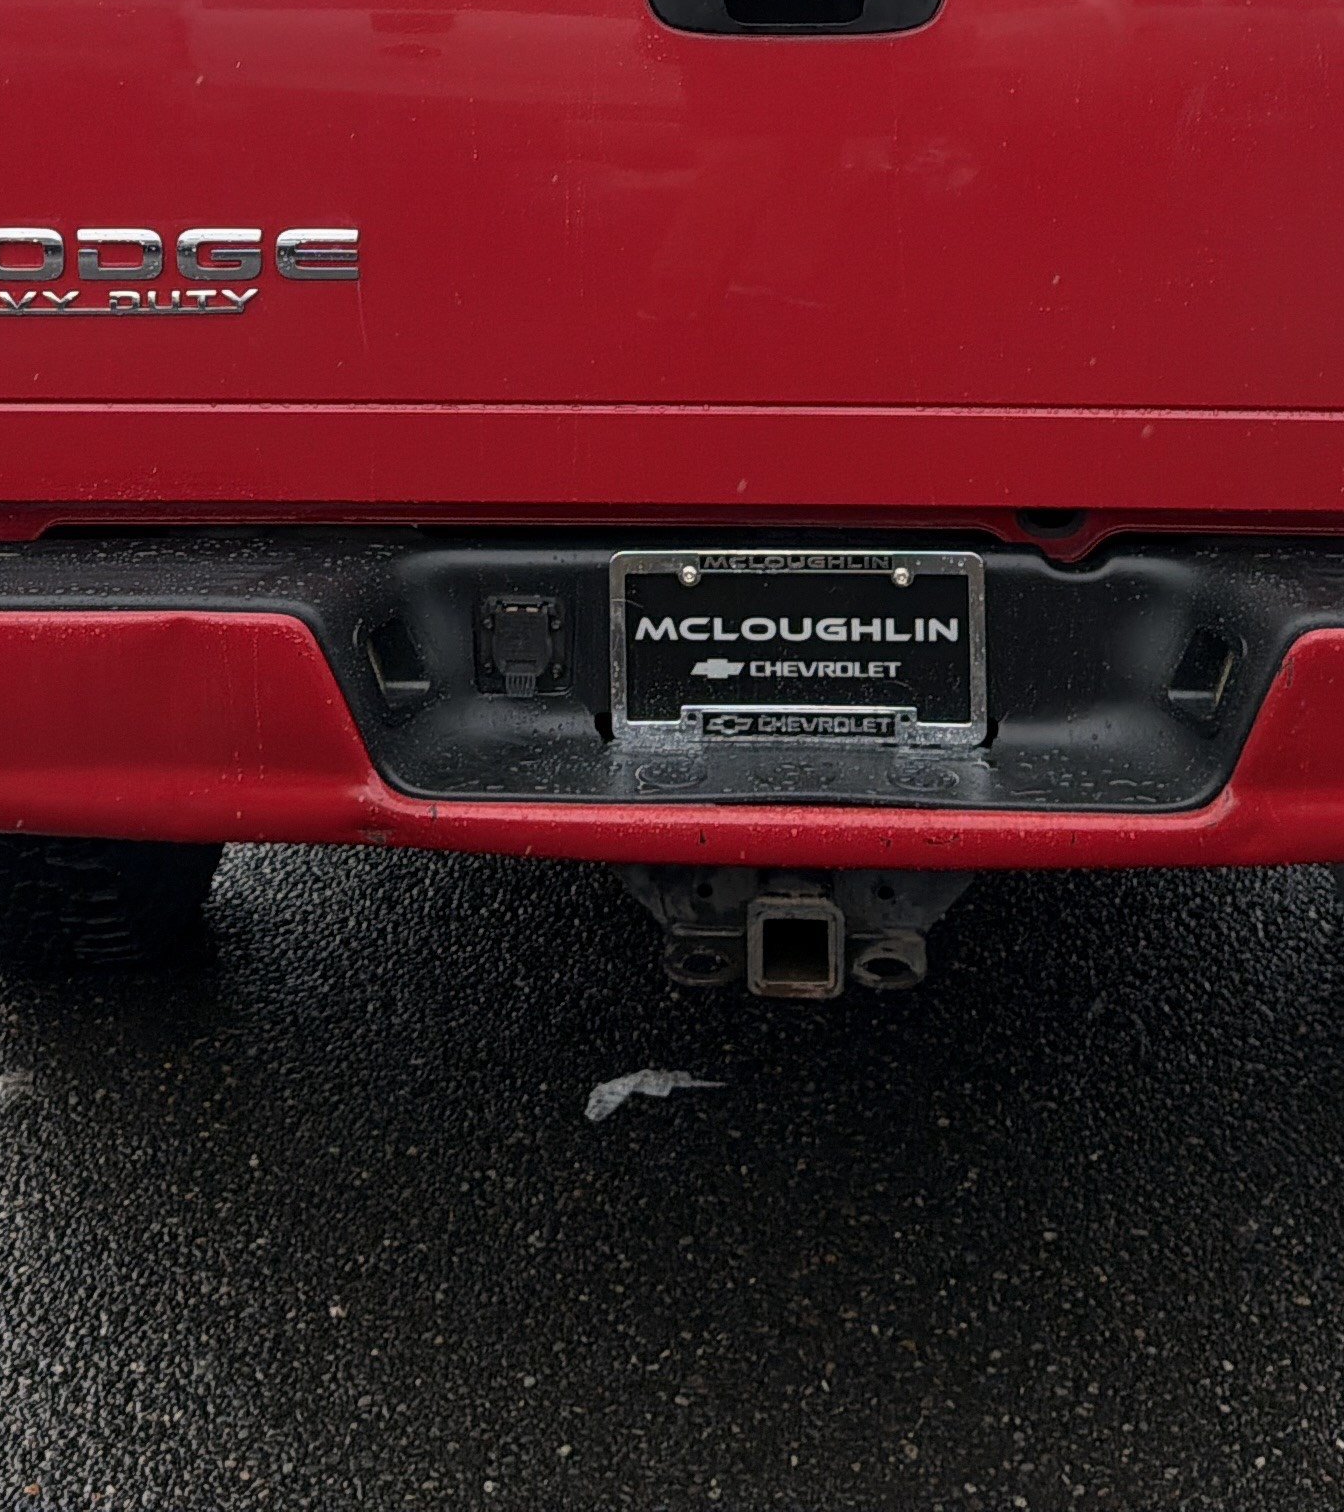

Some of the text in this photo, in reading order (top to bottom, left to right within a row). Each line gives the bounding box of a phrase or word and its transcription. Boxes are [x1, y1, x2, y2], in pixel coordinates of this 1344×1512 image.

[108, 287, 259, 316] DUTY
[703, 555, 890, 570] MCLOUGHLIN
[634, 615, 960, 643] MCLOUGHLIN
[748, 659, 902, 680] CHEVROLET
[757, 714, 892, 734] CHEVROLET
